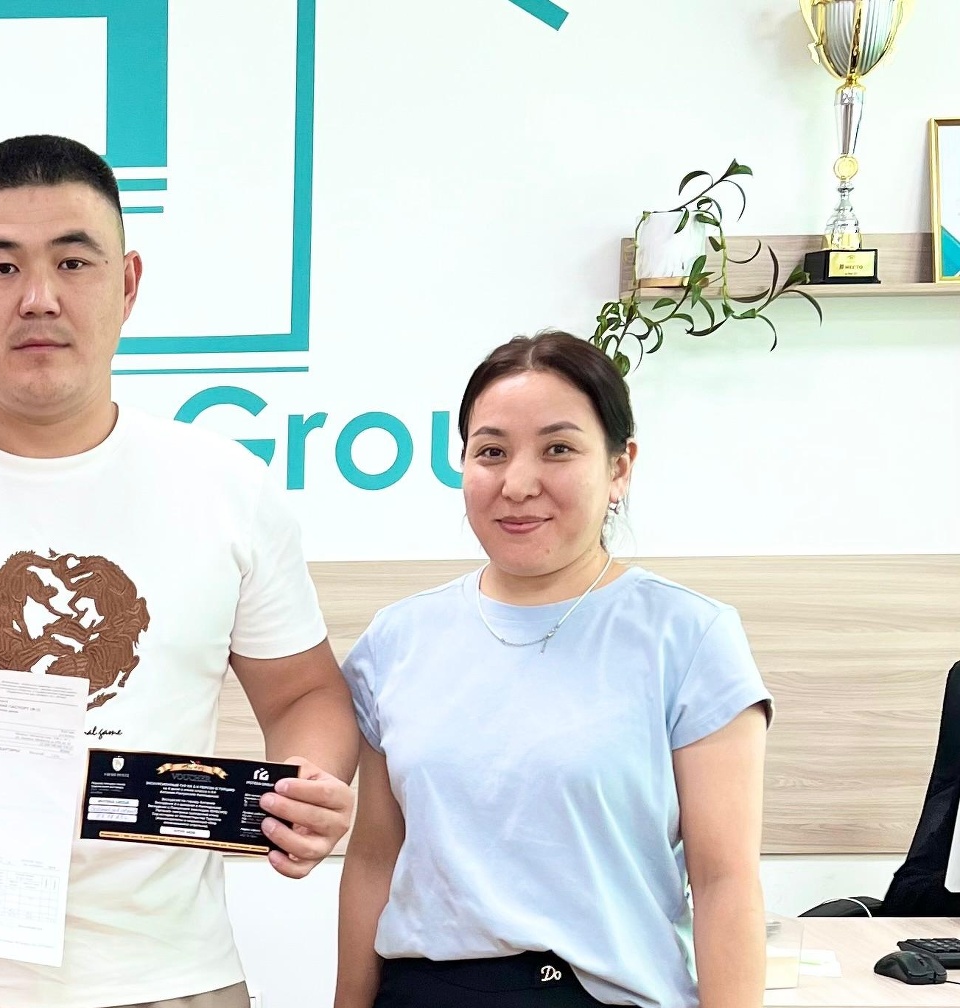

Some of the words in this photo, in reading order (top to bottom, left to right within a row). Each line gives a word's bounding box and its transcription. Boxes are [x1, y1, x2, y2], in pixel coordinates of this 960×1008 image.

[173, 385, 463, 490] Grou
[98, 728, 123, 740] game
[171, 772, 212, 783] VOUCHER
[540, 965, 562, 982] Do
